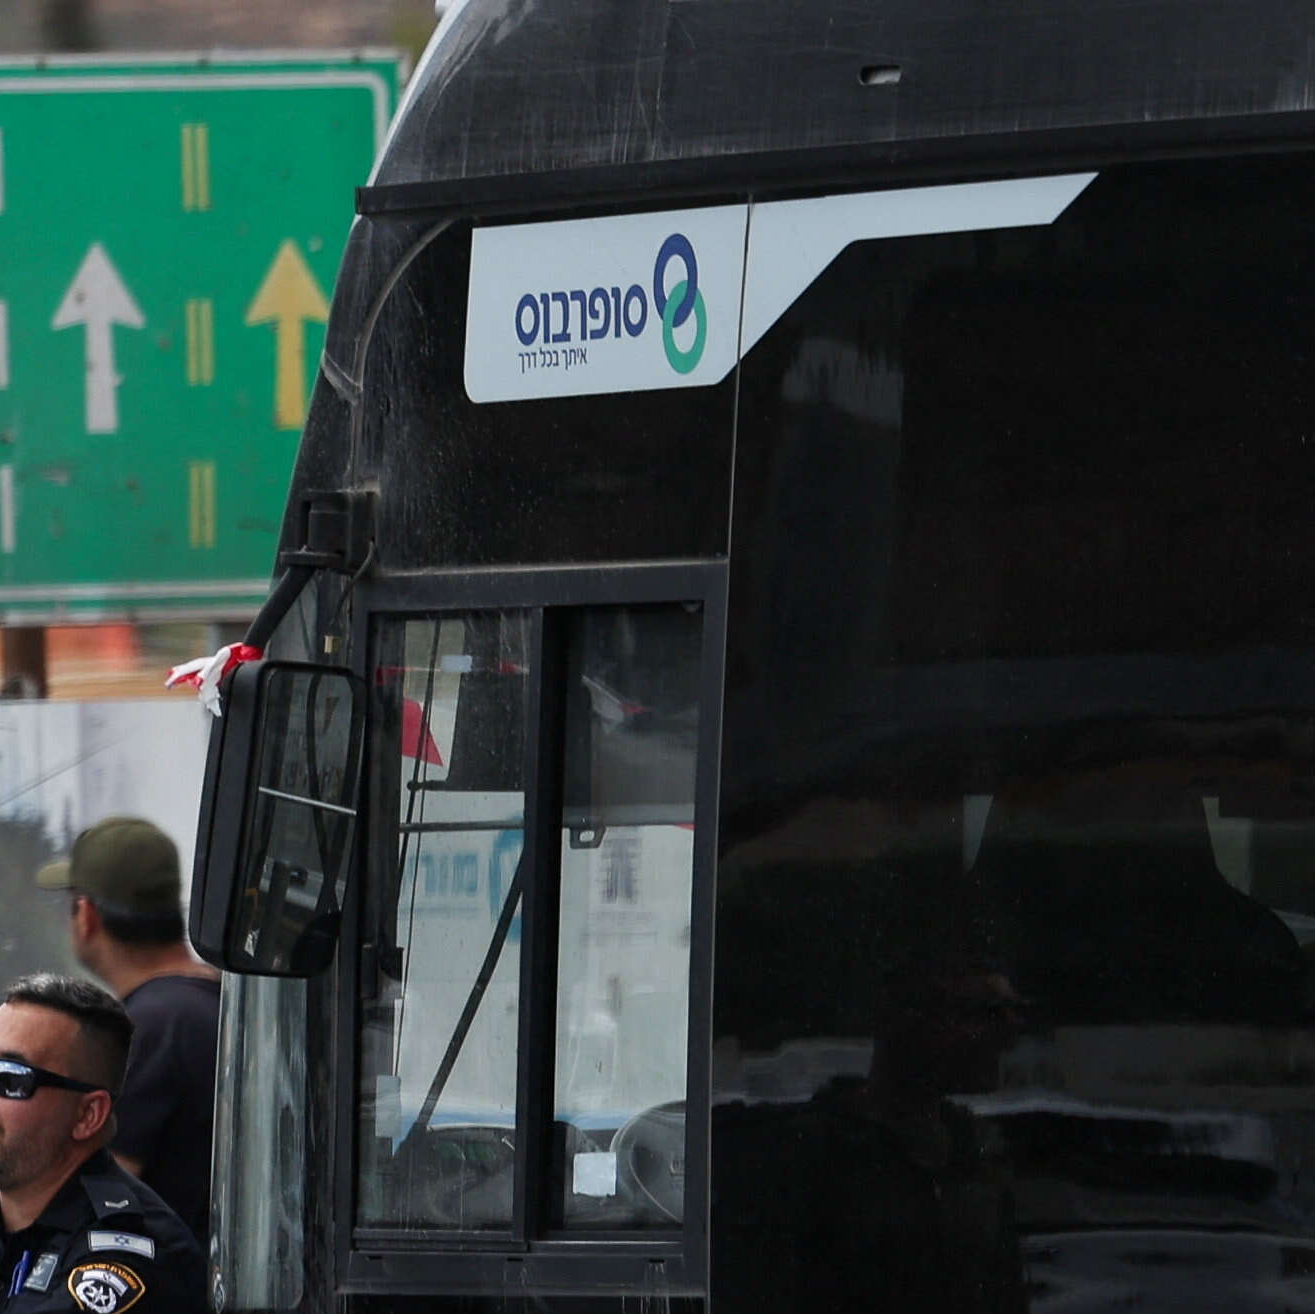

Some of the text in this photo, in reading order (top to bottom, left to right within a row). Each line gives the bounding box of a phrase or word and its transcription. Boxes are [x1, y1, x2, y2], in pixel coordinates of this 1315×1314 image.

[515, 284, 648, 346] סופרבוס
[518, 347, 588, 374] איתך בכל דרך
